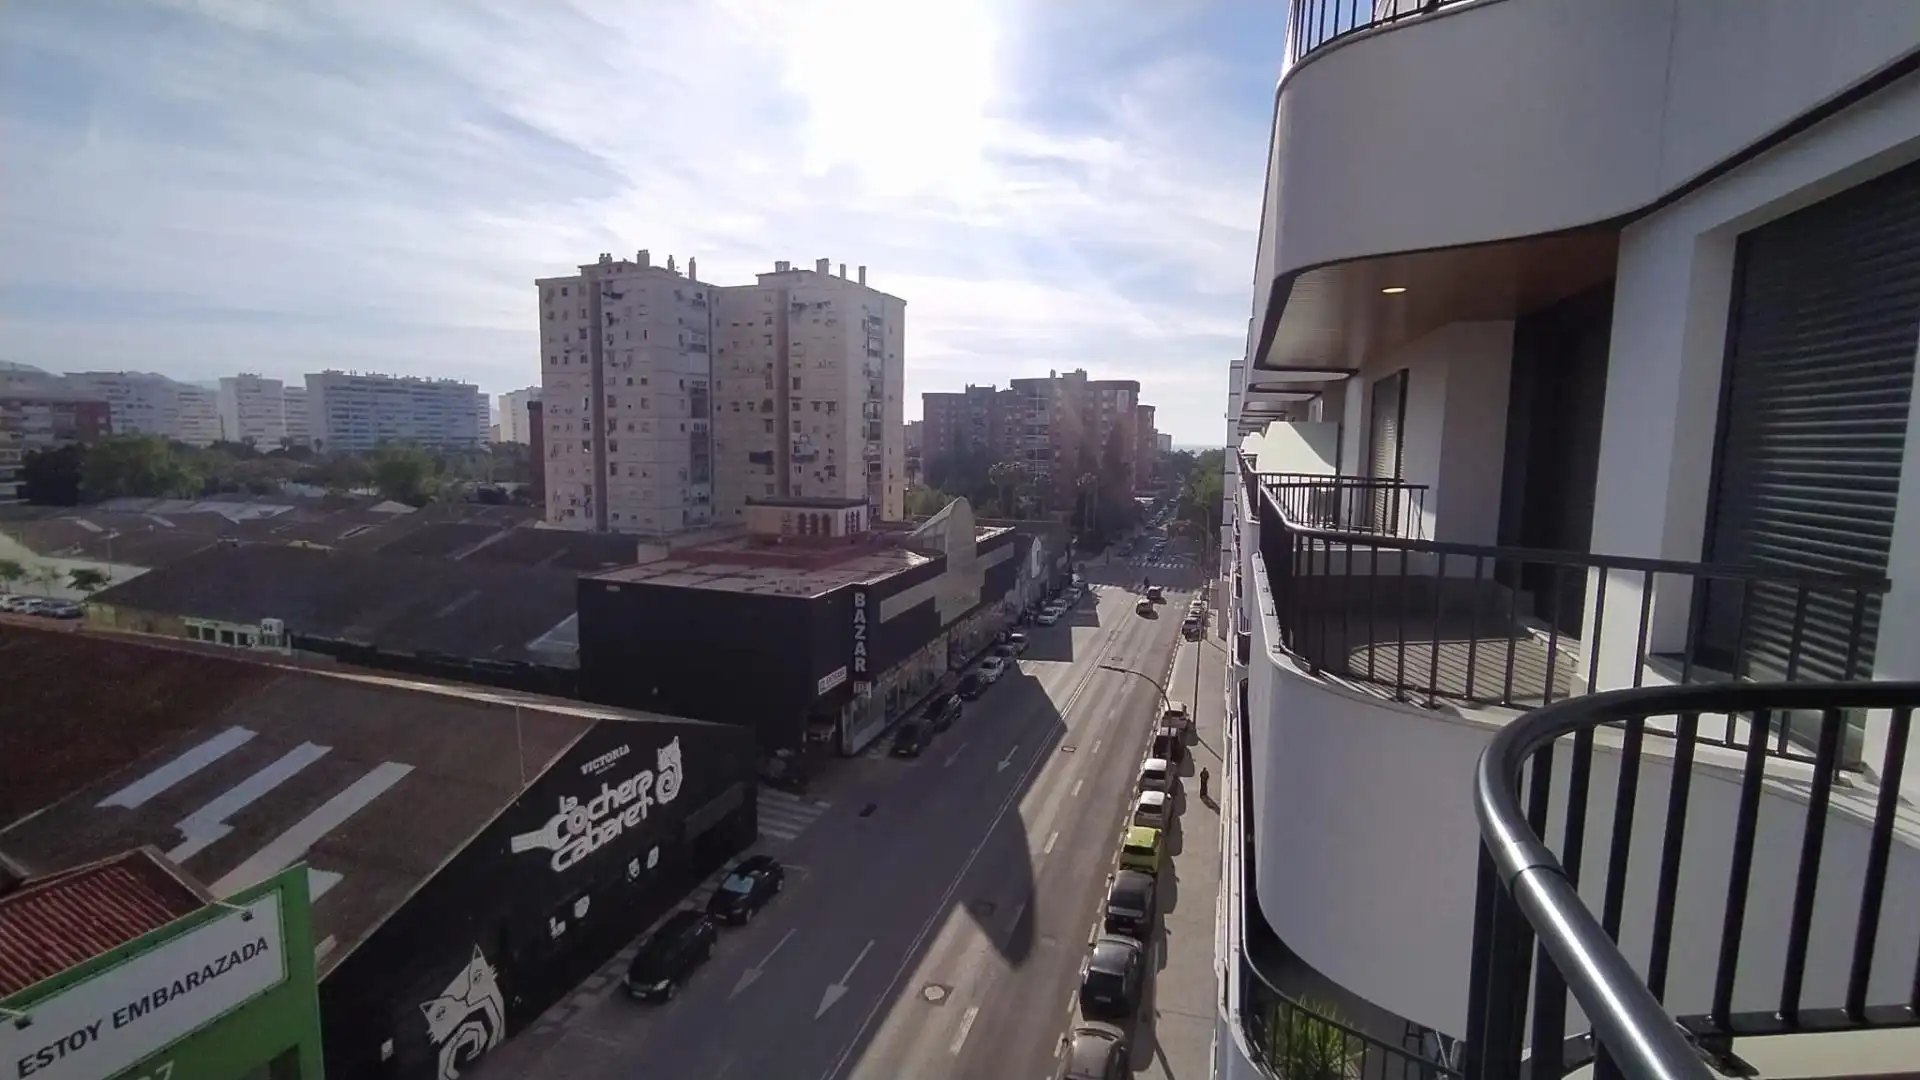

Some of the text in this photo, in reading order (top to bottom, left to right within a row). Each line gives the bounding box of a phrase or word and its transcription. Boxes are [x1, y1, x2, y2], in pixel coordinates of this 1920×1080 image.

[854, 592, 867, 672] BAZAR
[580, 743, 631, 775] VICTORIA
[17, 936, 269, 1079] ESTOY EMBARAZADA
